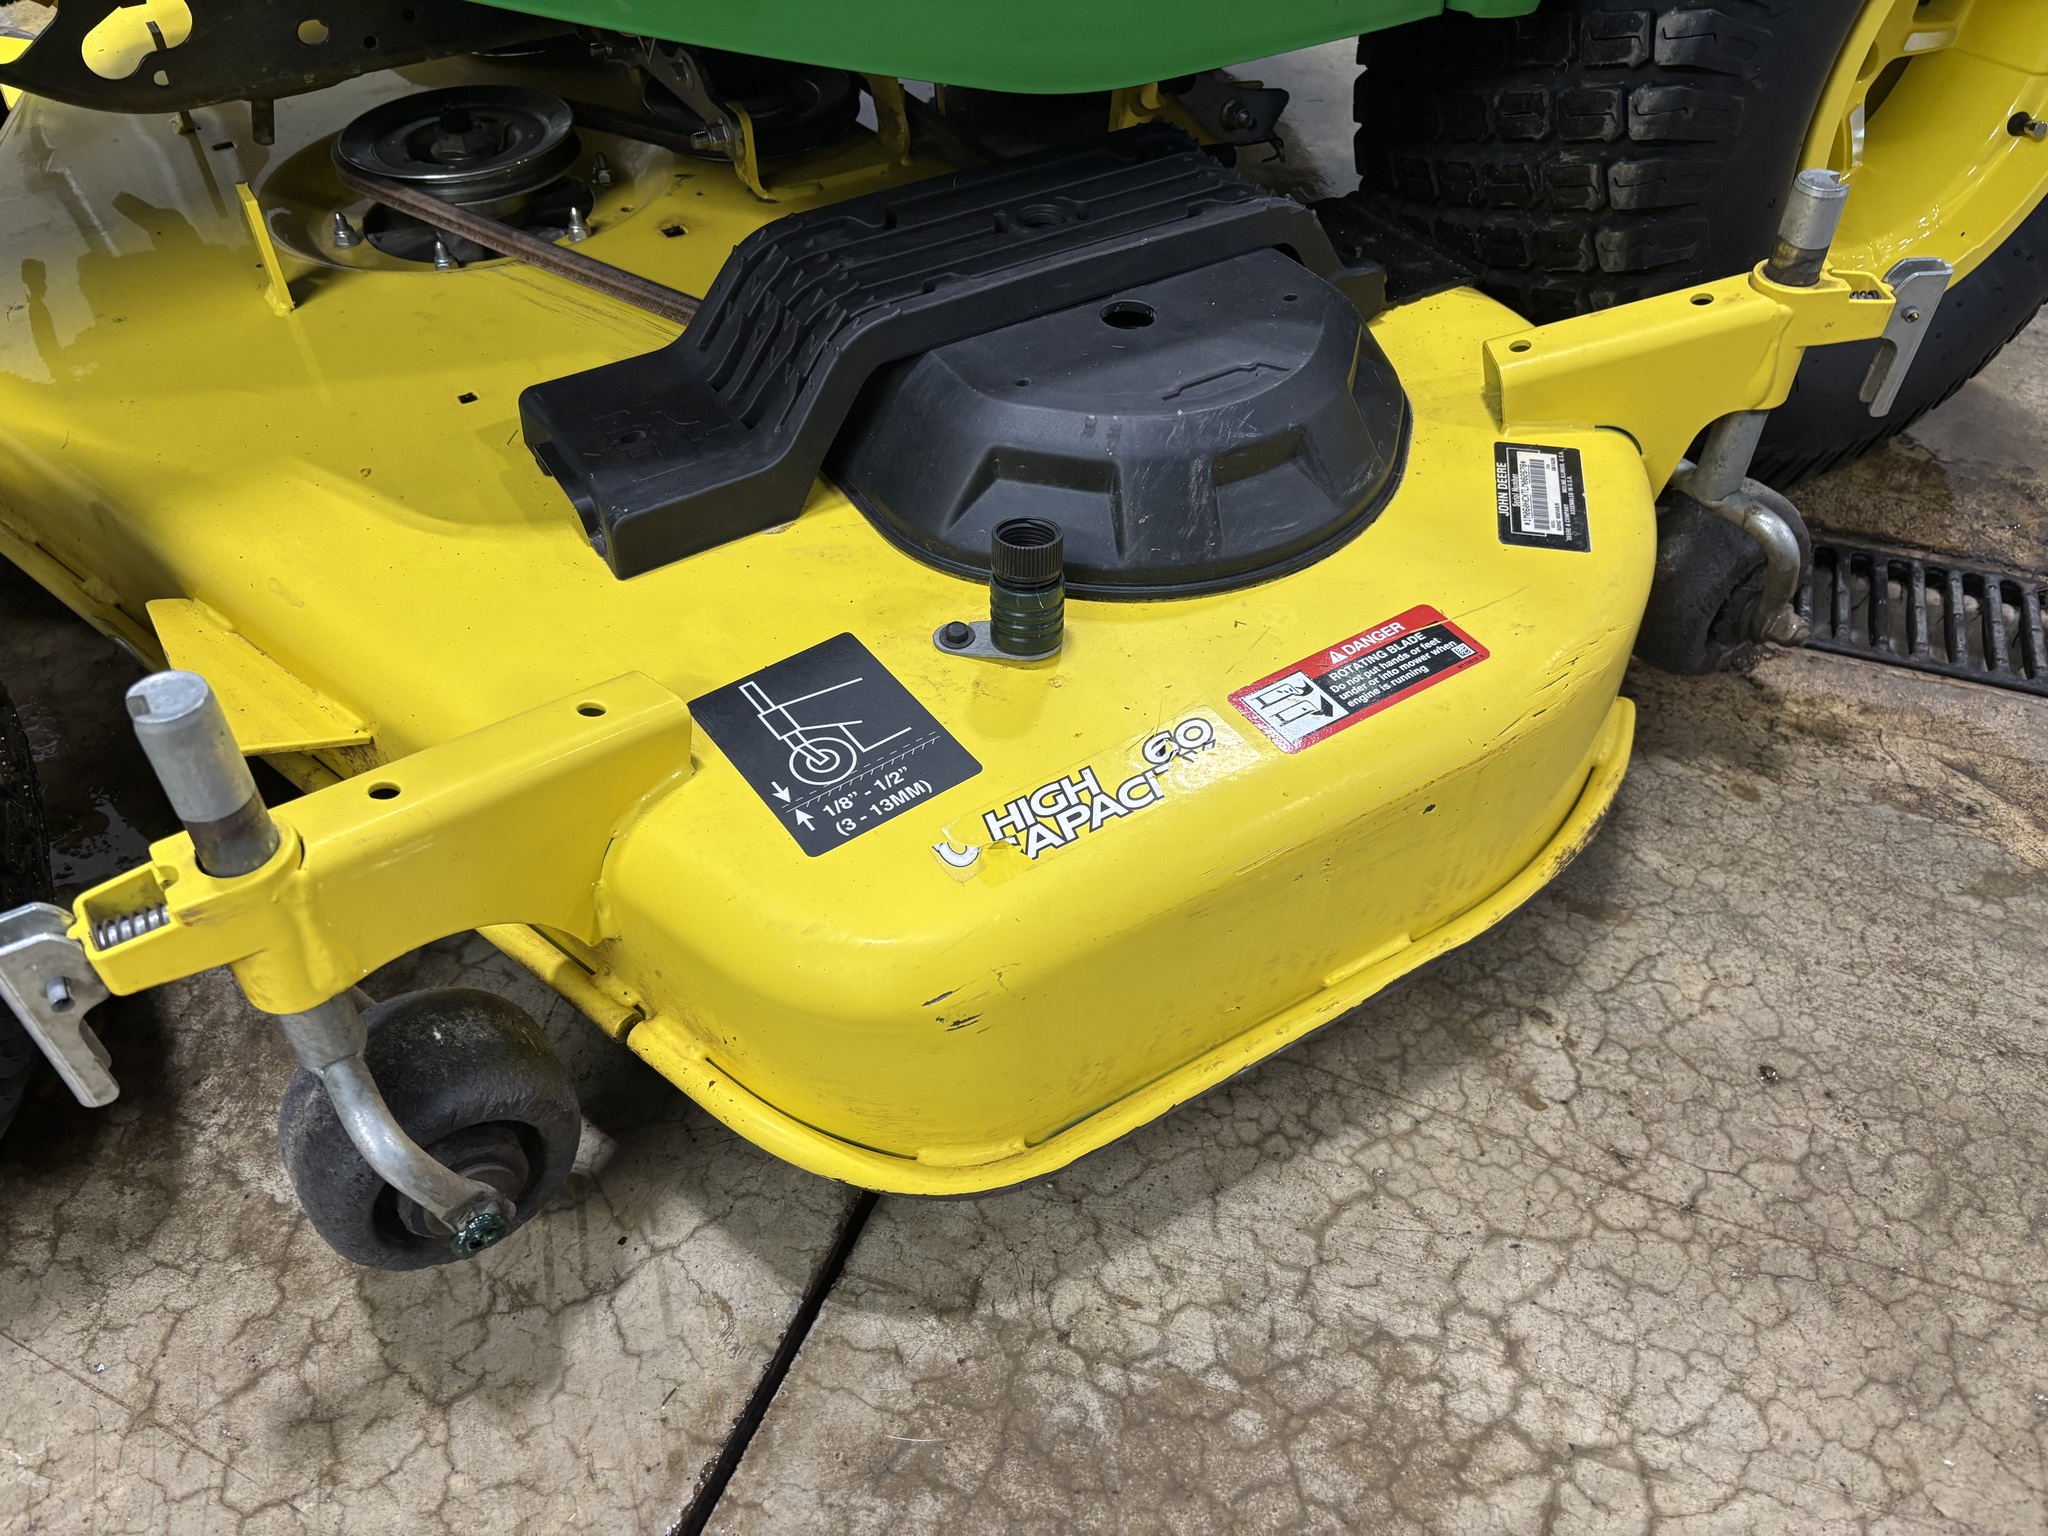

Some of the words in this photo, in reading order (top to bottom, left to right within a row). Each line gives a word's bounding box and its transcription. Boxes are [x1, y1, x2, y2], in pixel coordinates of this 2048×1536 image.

[1496, 462, 1508, 490] DEERE
[1511, 473, 1519, 492] Number
[1498, 492, 1510, 517] JOHN
[1511, 492, 1520, 507] Serial
[1328, 648, 1389, 682] ROTATING
[1386, 631, 1427, 654] BLADE
[1341, 621, 1406, 656] DANGER
[1329, 682, 1346, 693] Do
[1346, 674, 1364, 685] not
[1363, 666, 1381, 679] put
[1379, 652, 1411, 672] hands
[1409, 646, 1421, 656] or
[1420, 637, 1441, 650] feet
[1339, 682, 1369, 700] under
[1368, 676, 1380, 686] or
[1378, 667, 1400, 681] into
[1399, 652, 1431, 671] mower
[1430, 640, 1458, 656] when
[1347, 687, 1381, 707] engine
[1379, 682, 1392, 691] is
[1390, 665, 1430, 686] running
[822, 791, 858, 818] 1/8”
[873, 766, 909, 793] 1/2”
[982, 765, 1103, 844] HIGH
[1141, 717, 1216, 766] 60
[835, 817, 857, 836] (3
[869, 779, 934, 817] 13MM)
